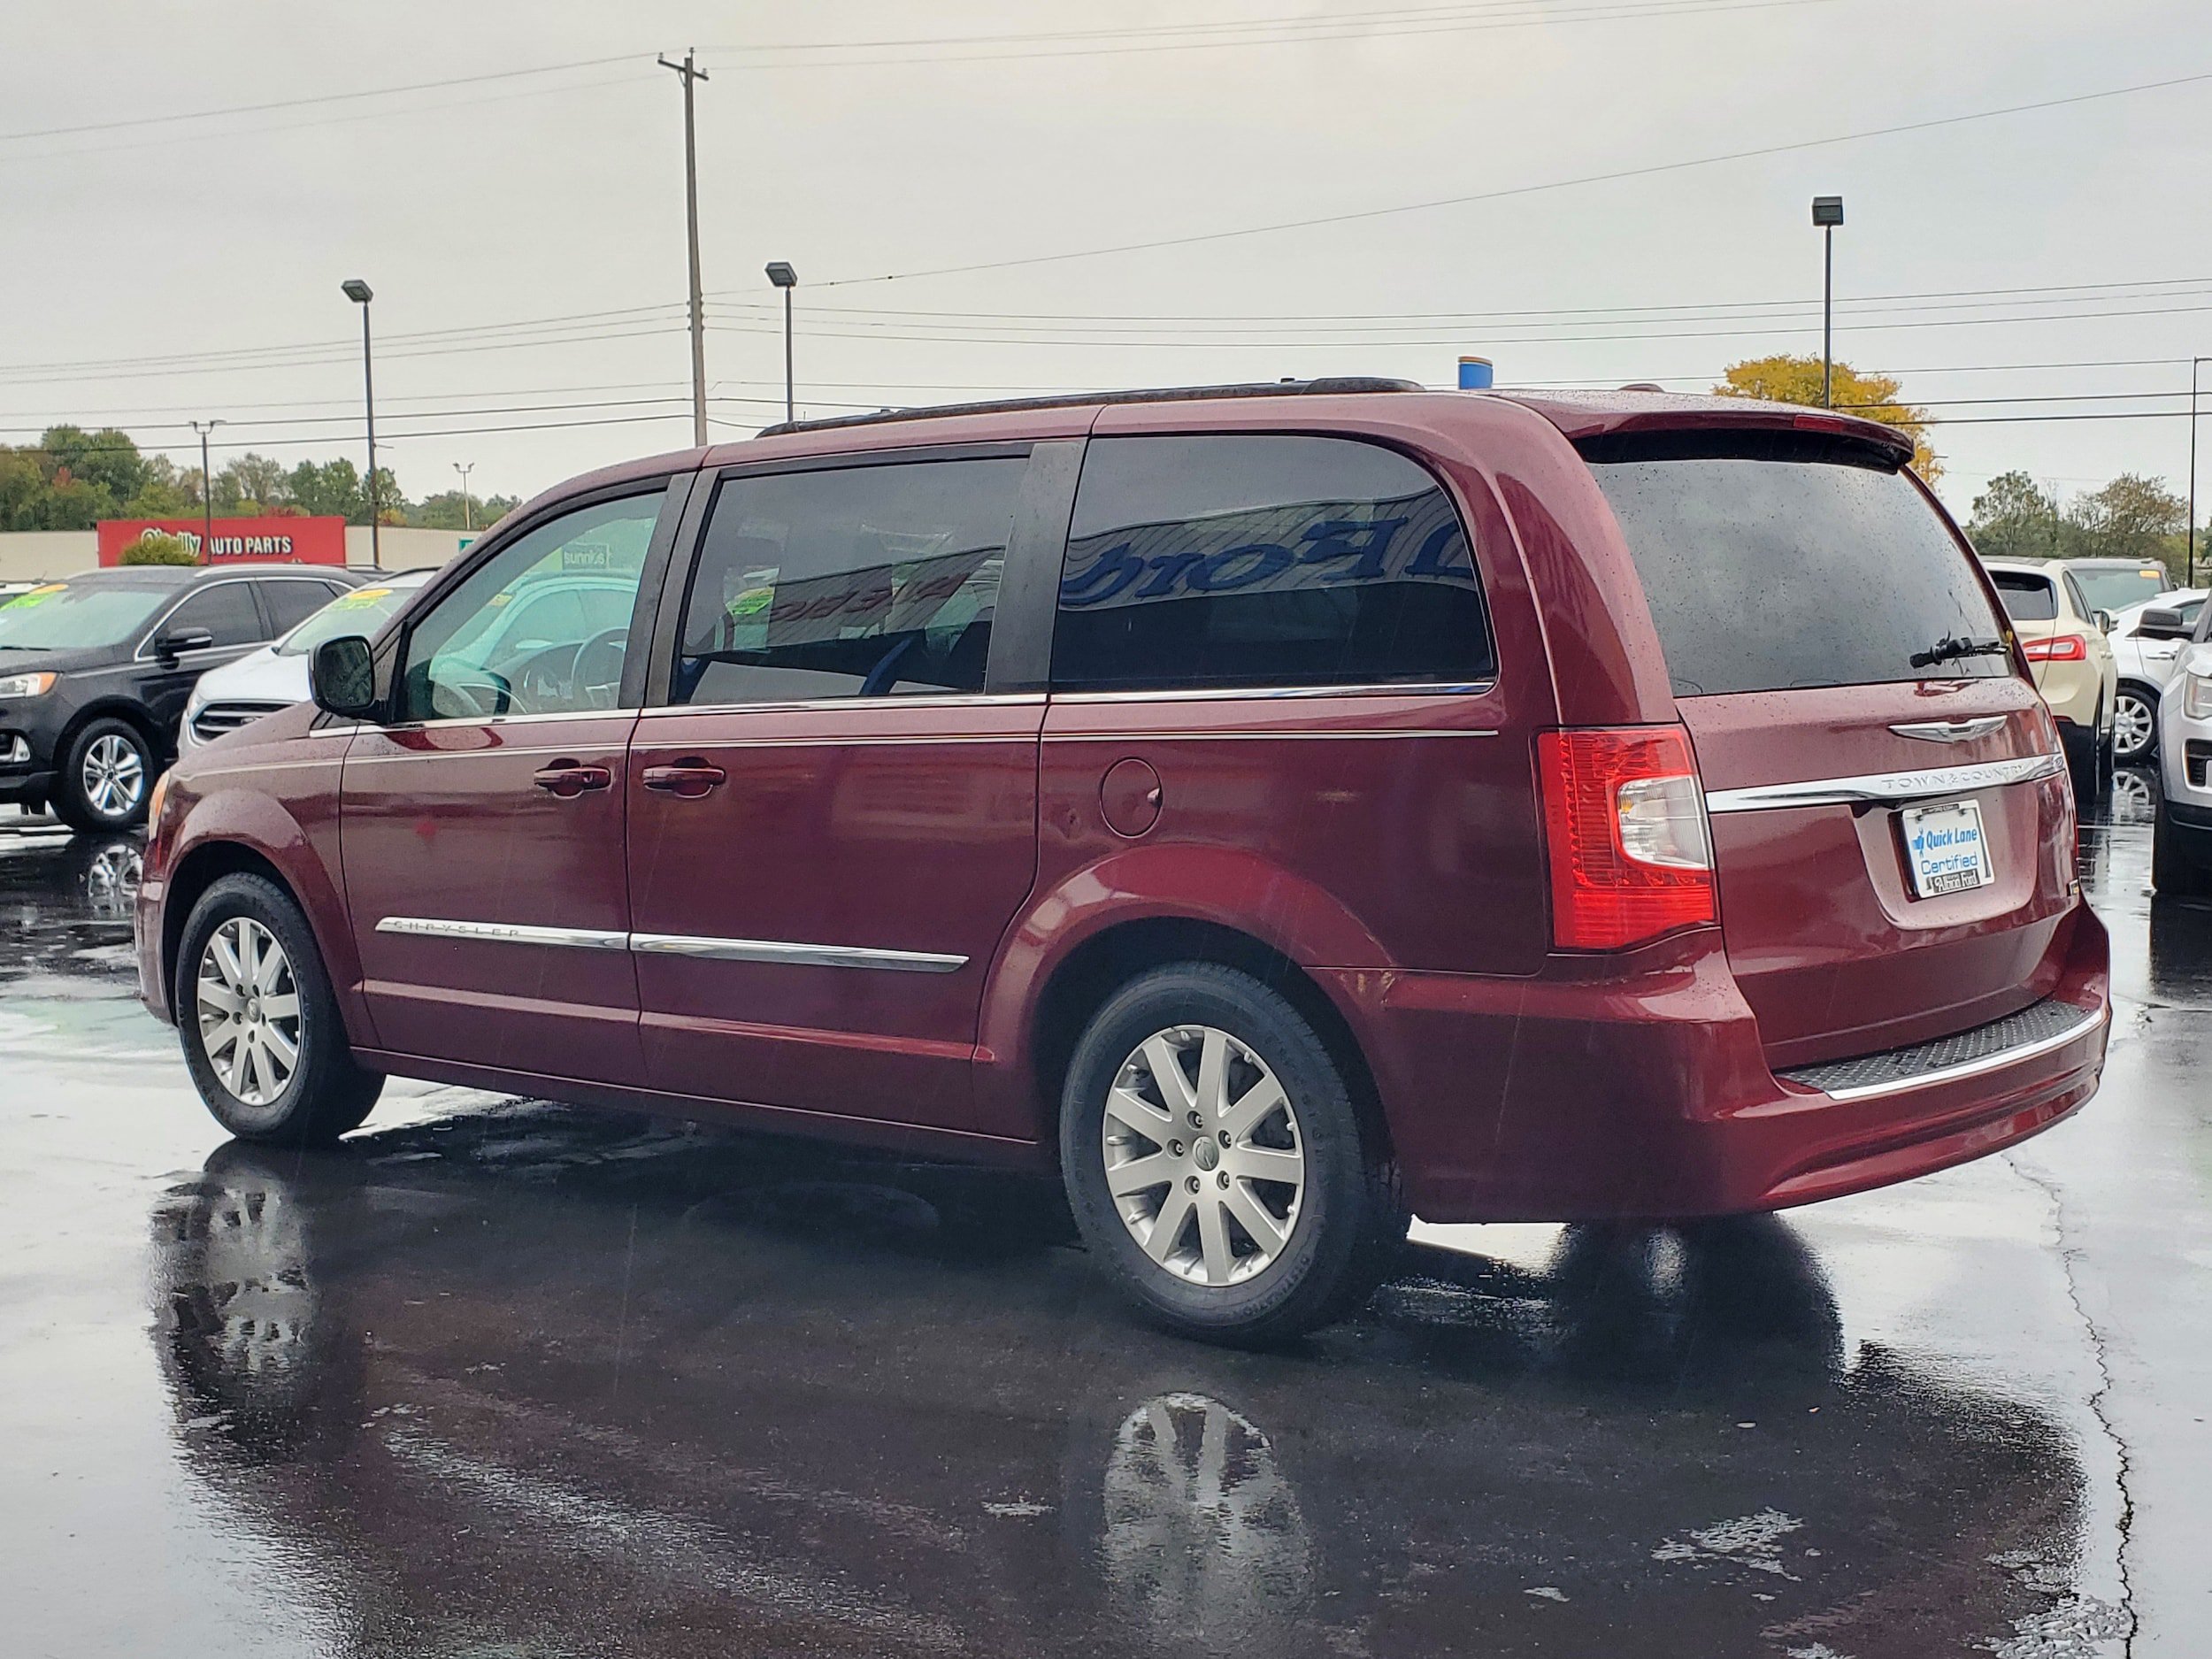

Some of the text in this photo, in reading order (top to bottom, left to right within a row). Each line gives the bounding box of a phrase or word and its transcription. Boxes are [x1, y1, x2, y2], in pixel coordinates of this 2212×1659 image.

[246, 535, 292, 555] PARTS
[1926, 827, 1978, 849] Quick Lane
[1921, 852, 1978, 875] Certified
[394, 920, 519, 937] CHRYSLER
